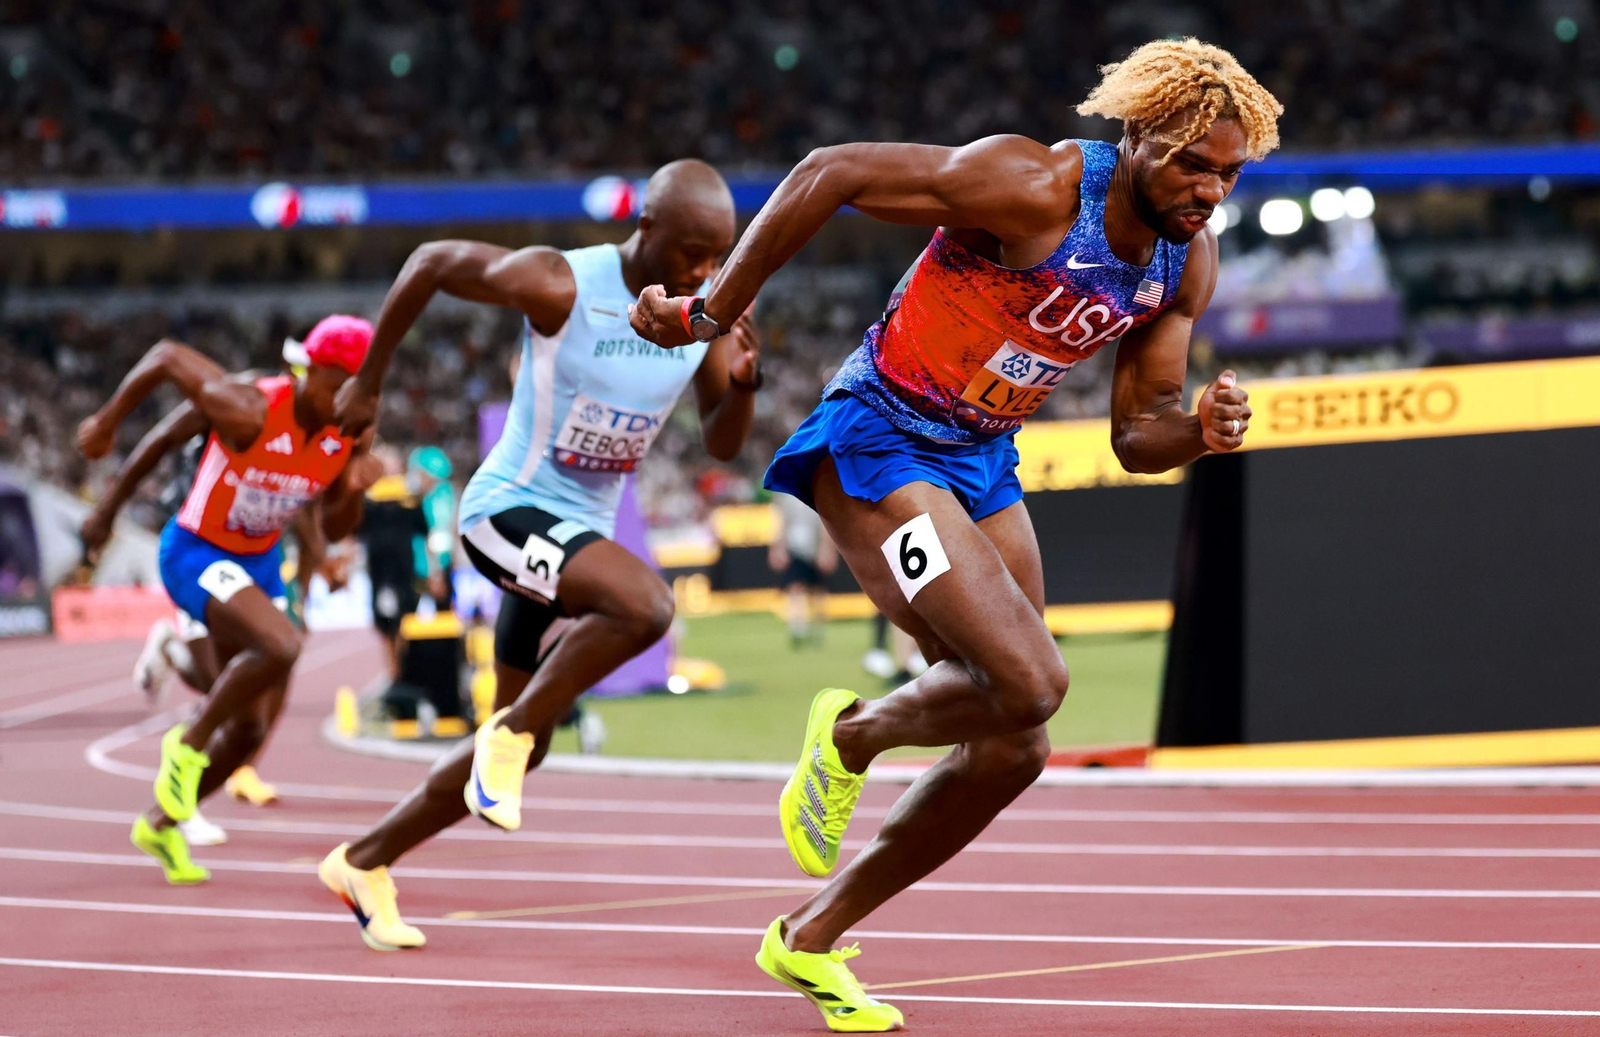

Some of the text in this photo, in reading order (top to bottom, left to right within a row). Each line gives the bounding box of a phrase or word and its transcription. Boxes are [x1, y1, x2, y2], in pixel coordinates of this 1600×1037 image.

[1030, 361, 1071, 386] TD
[978, 379, 1050, 414] LYLE
[1268, 380, 1459, 434] SEIKO
[570, 426, 645, 458] TEBOG
[526, 554, 549, 581] 5
[899, 531, 928, 580] 6
